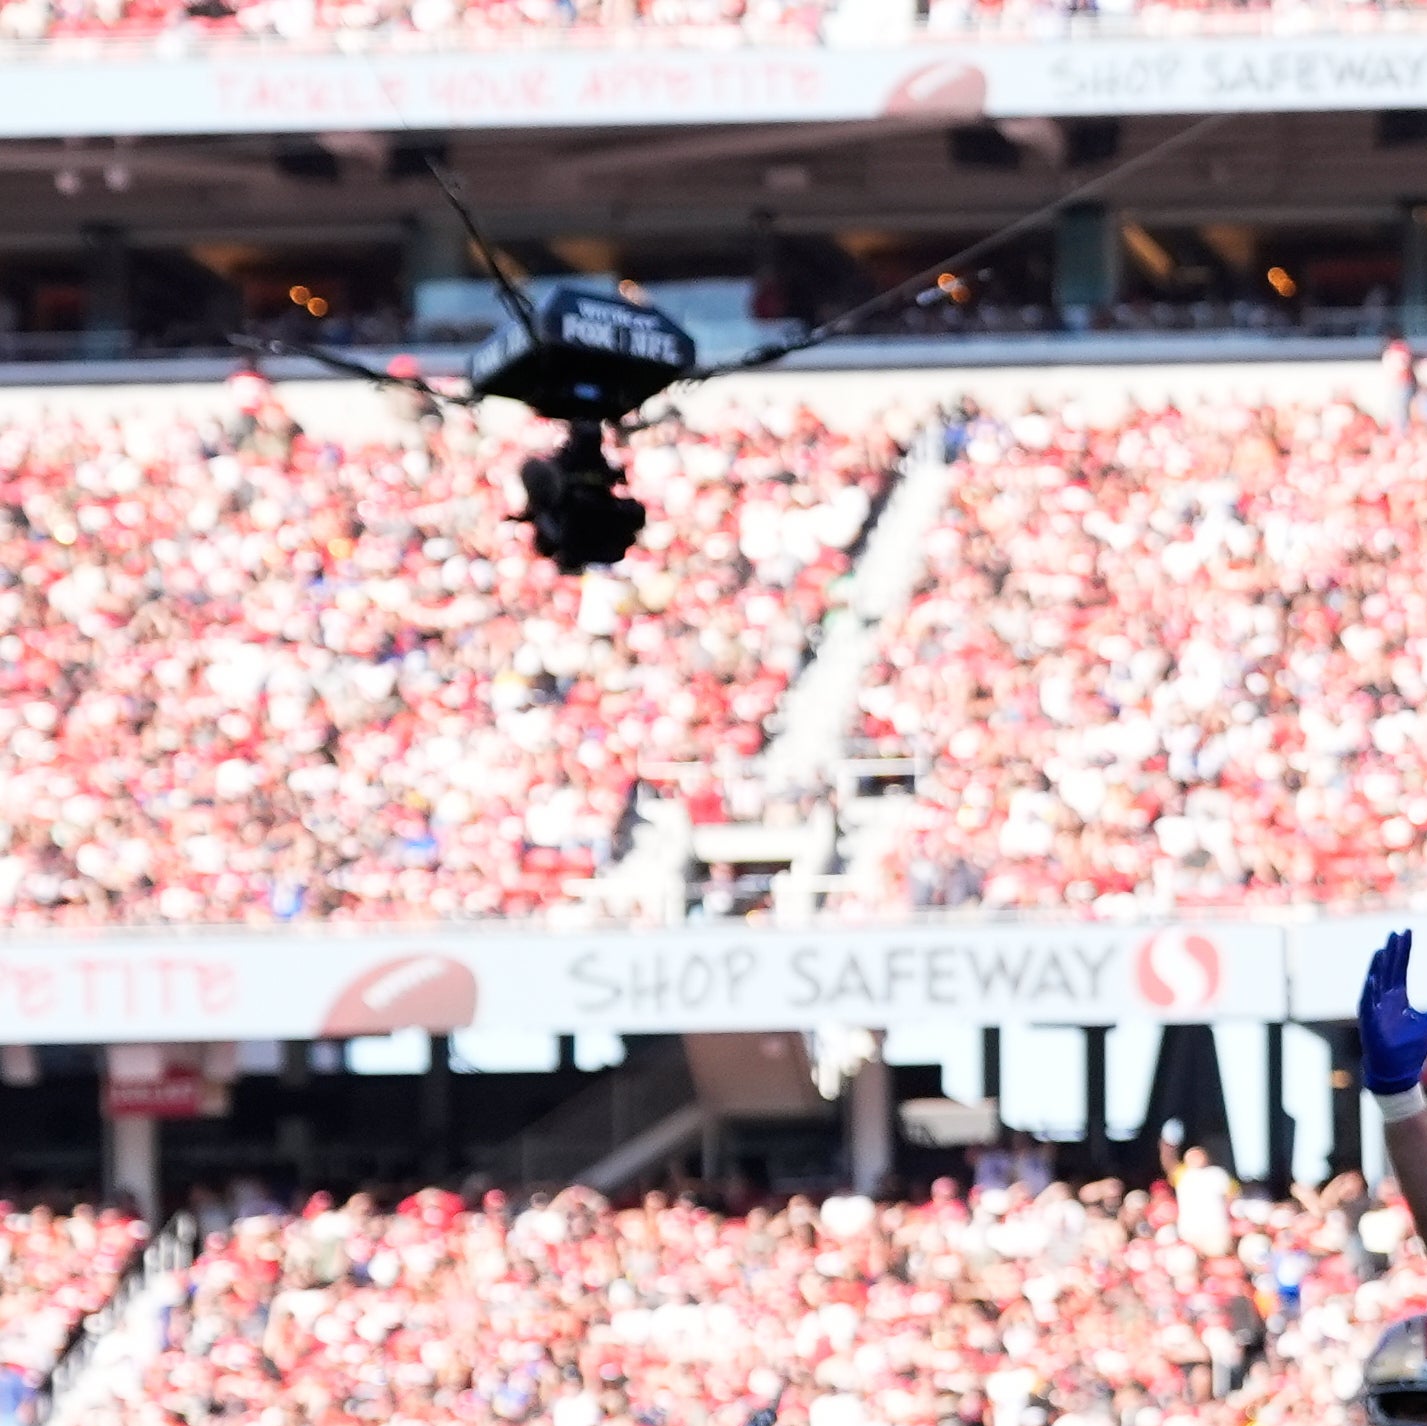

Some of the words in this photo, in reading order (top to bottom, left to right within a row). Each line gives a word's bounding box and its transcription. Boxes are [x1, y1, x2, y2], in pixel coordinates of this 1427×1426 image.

[1050, 54, 1182, 98] SHOP
[568, 946, 760, 1010] SHOP
[789, 943, 1116, 1010] SAFEWAY
